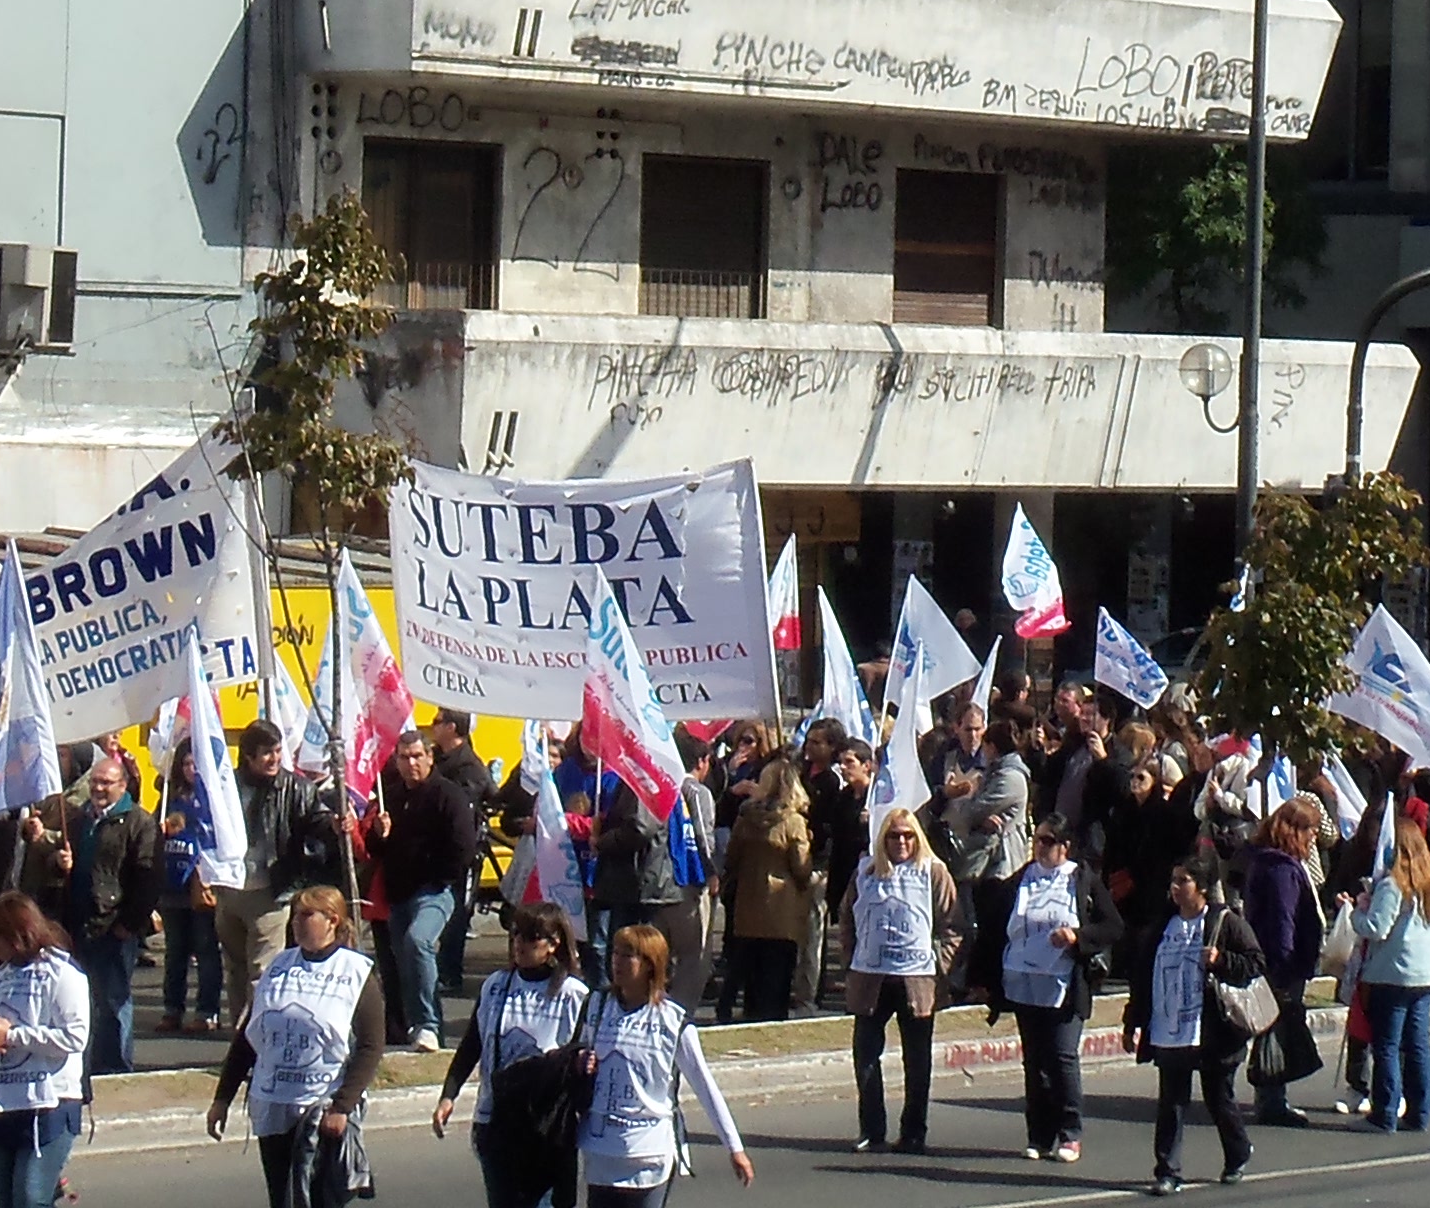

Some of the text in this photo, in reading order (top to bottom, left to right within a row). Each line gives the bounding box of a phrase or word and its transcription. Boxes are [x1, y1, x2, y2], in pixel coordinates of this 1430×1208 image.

[1074, 37, 1181, 98] LOBO
[408, 487, 684, 565] SUTEBA
[27, 512, 217, 626] BROWN
[415, 557, 695, 631] LA PLATA
[422, 626, 485, 663] DEFENSA
[485, 647, 510, 665] DE
[513, 649, 540, 668] LA
[646, 642, 749, 668] PUBLICA
[423, 662, 487, 698] CTERA
